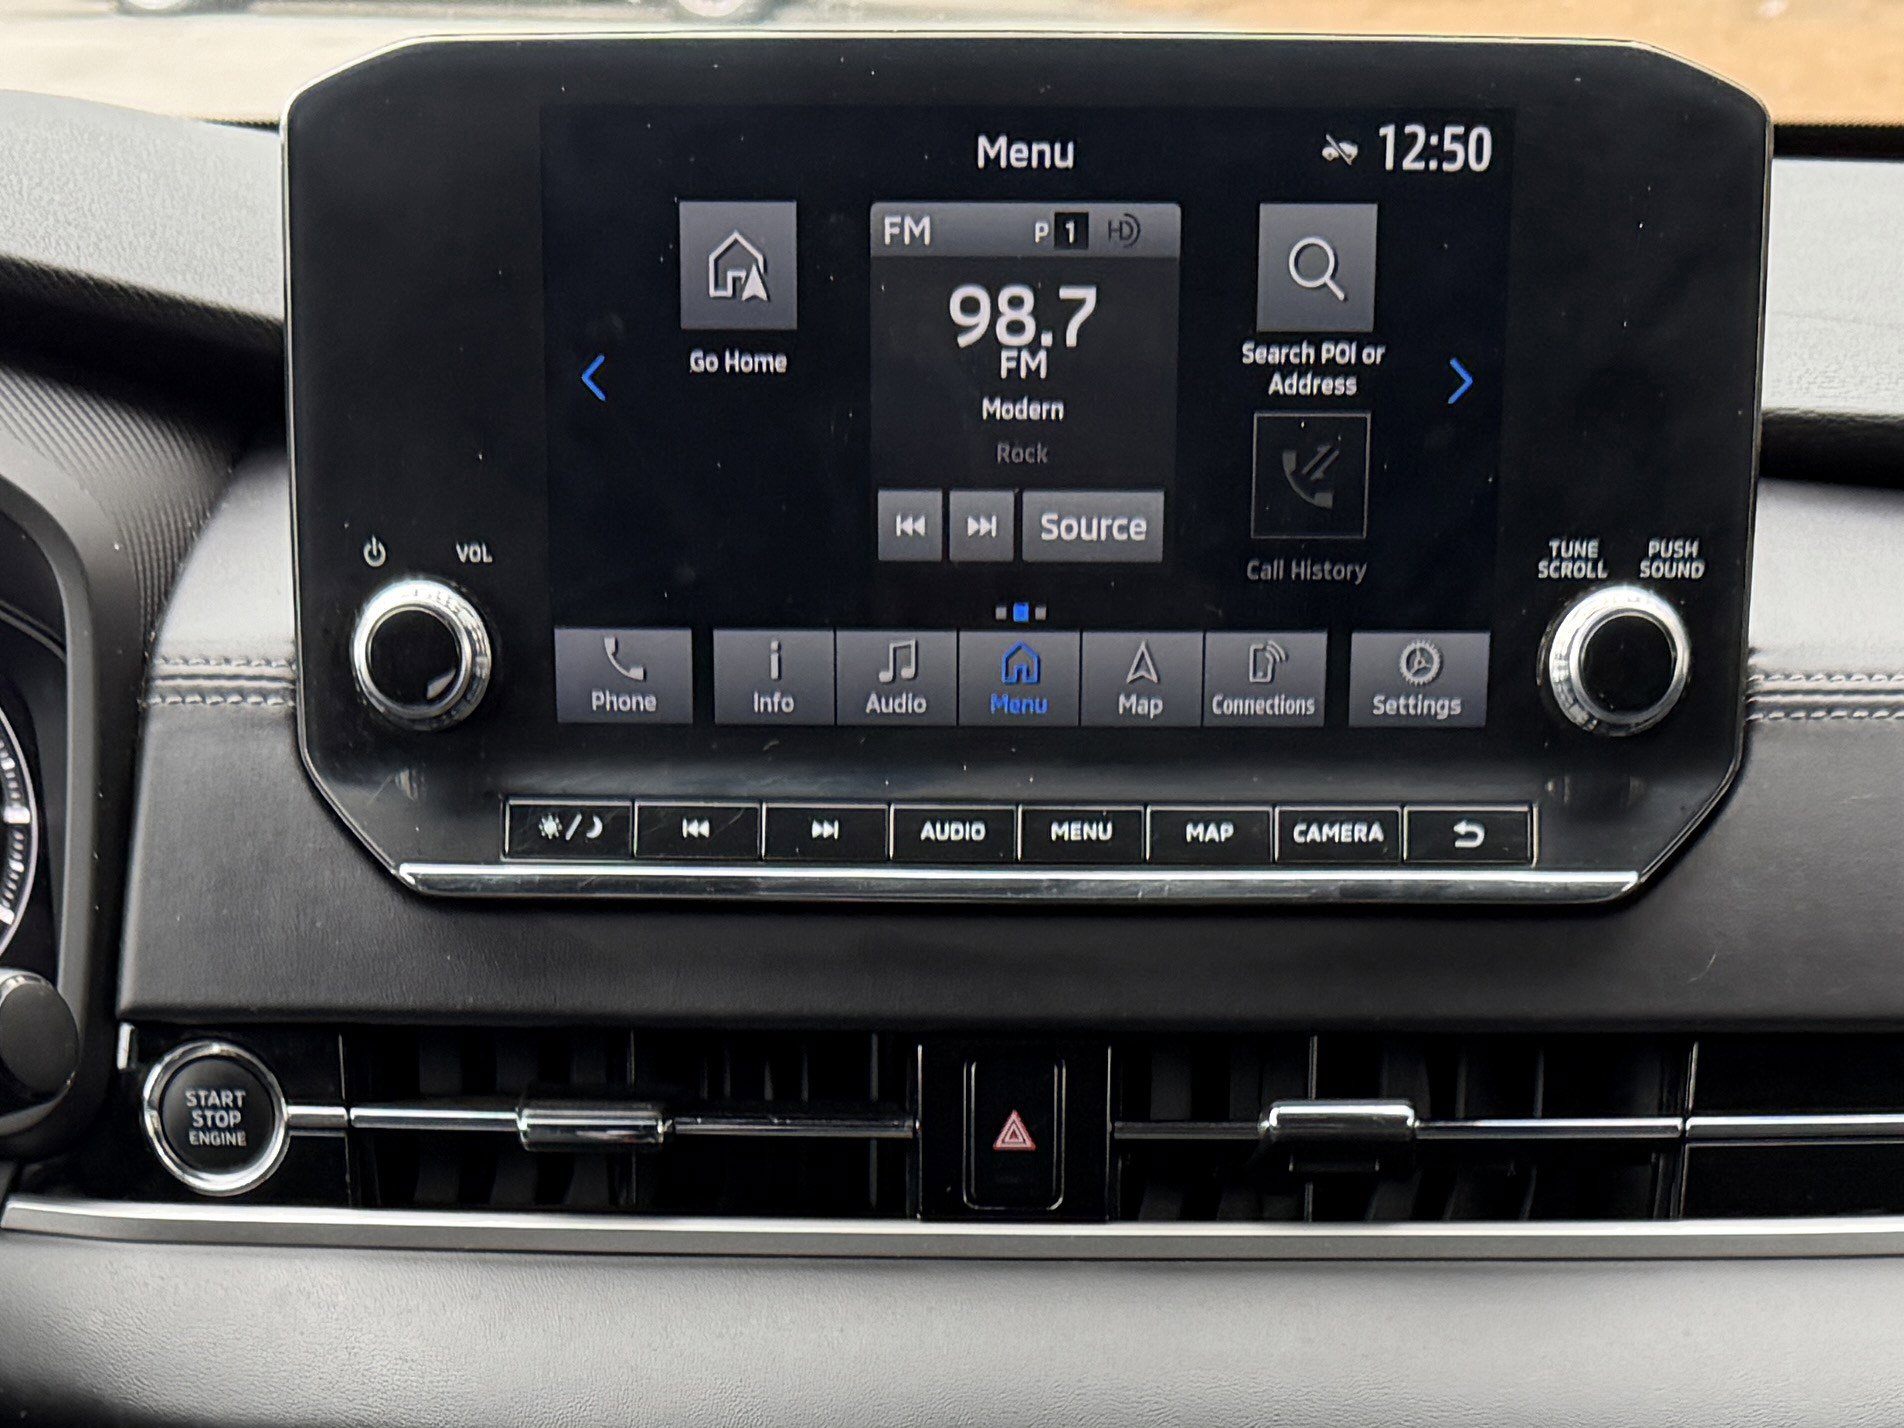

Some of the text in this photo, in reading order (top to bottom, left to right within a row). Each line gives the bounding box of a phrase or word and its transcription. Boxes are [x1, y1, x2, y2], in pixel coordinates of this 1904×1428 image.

[977, 136, 1075, 169] Menu
[1378, 125, 1493, 172] 12:50
[883, 217, 931, 245] FM
[1034, 221, 1048, 242] P
[1064, 221, 1075, 243] 1
[949, 285, 1096, 348] 98.7
[689, 351, 788, 373] Go Home
[1001, 352, 1047, 379] FM
[1242, 342, 1386, 366] Search POI or
[1268, 372, 1357, 396] Address
[982, 398, 1064, 421] Modern
[996, 442, 1048, 464] Rock
[1041, 513, 1148, 542] Source
[456, 543, 493, 563] VOL
[1549, 539, 1600, 558] TUNE
[1648, 540, 1698, 558] PUSH
[1246, 559, 1367, 585] Call History
[1538, 561, 1609, 580] SCROLL
[1639, 561, 1705, 580] SOUND
[591, 691, 658, 714] Phone
[753, 691, 795, 714] Info
[866, 692, 927, 715] Audio
[991, 693, 1048, 715] Menu
[1118, 694, 1164, 719] Map
[1212, 694, 1316, 717] Connections
[1372, 693, 1462, 719] Settings
[921, 821, 986, 842] AUDIO
[1051, 821, 1113, 842] MENU
[1186, 822, 1234, 843] MAP
[1292, 822, 1385, 844] CAMERA
[185, 1090, 246, 1108] START
[192, 1110, 242, 1128] STOP
[189, 1131, 246, 1146] ENGINE
